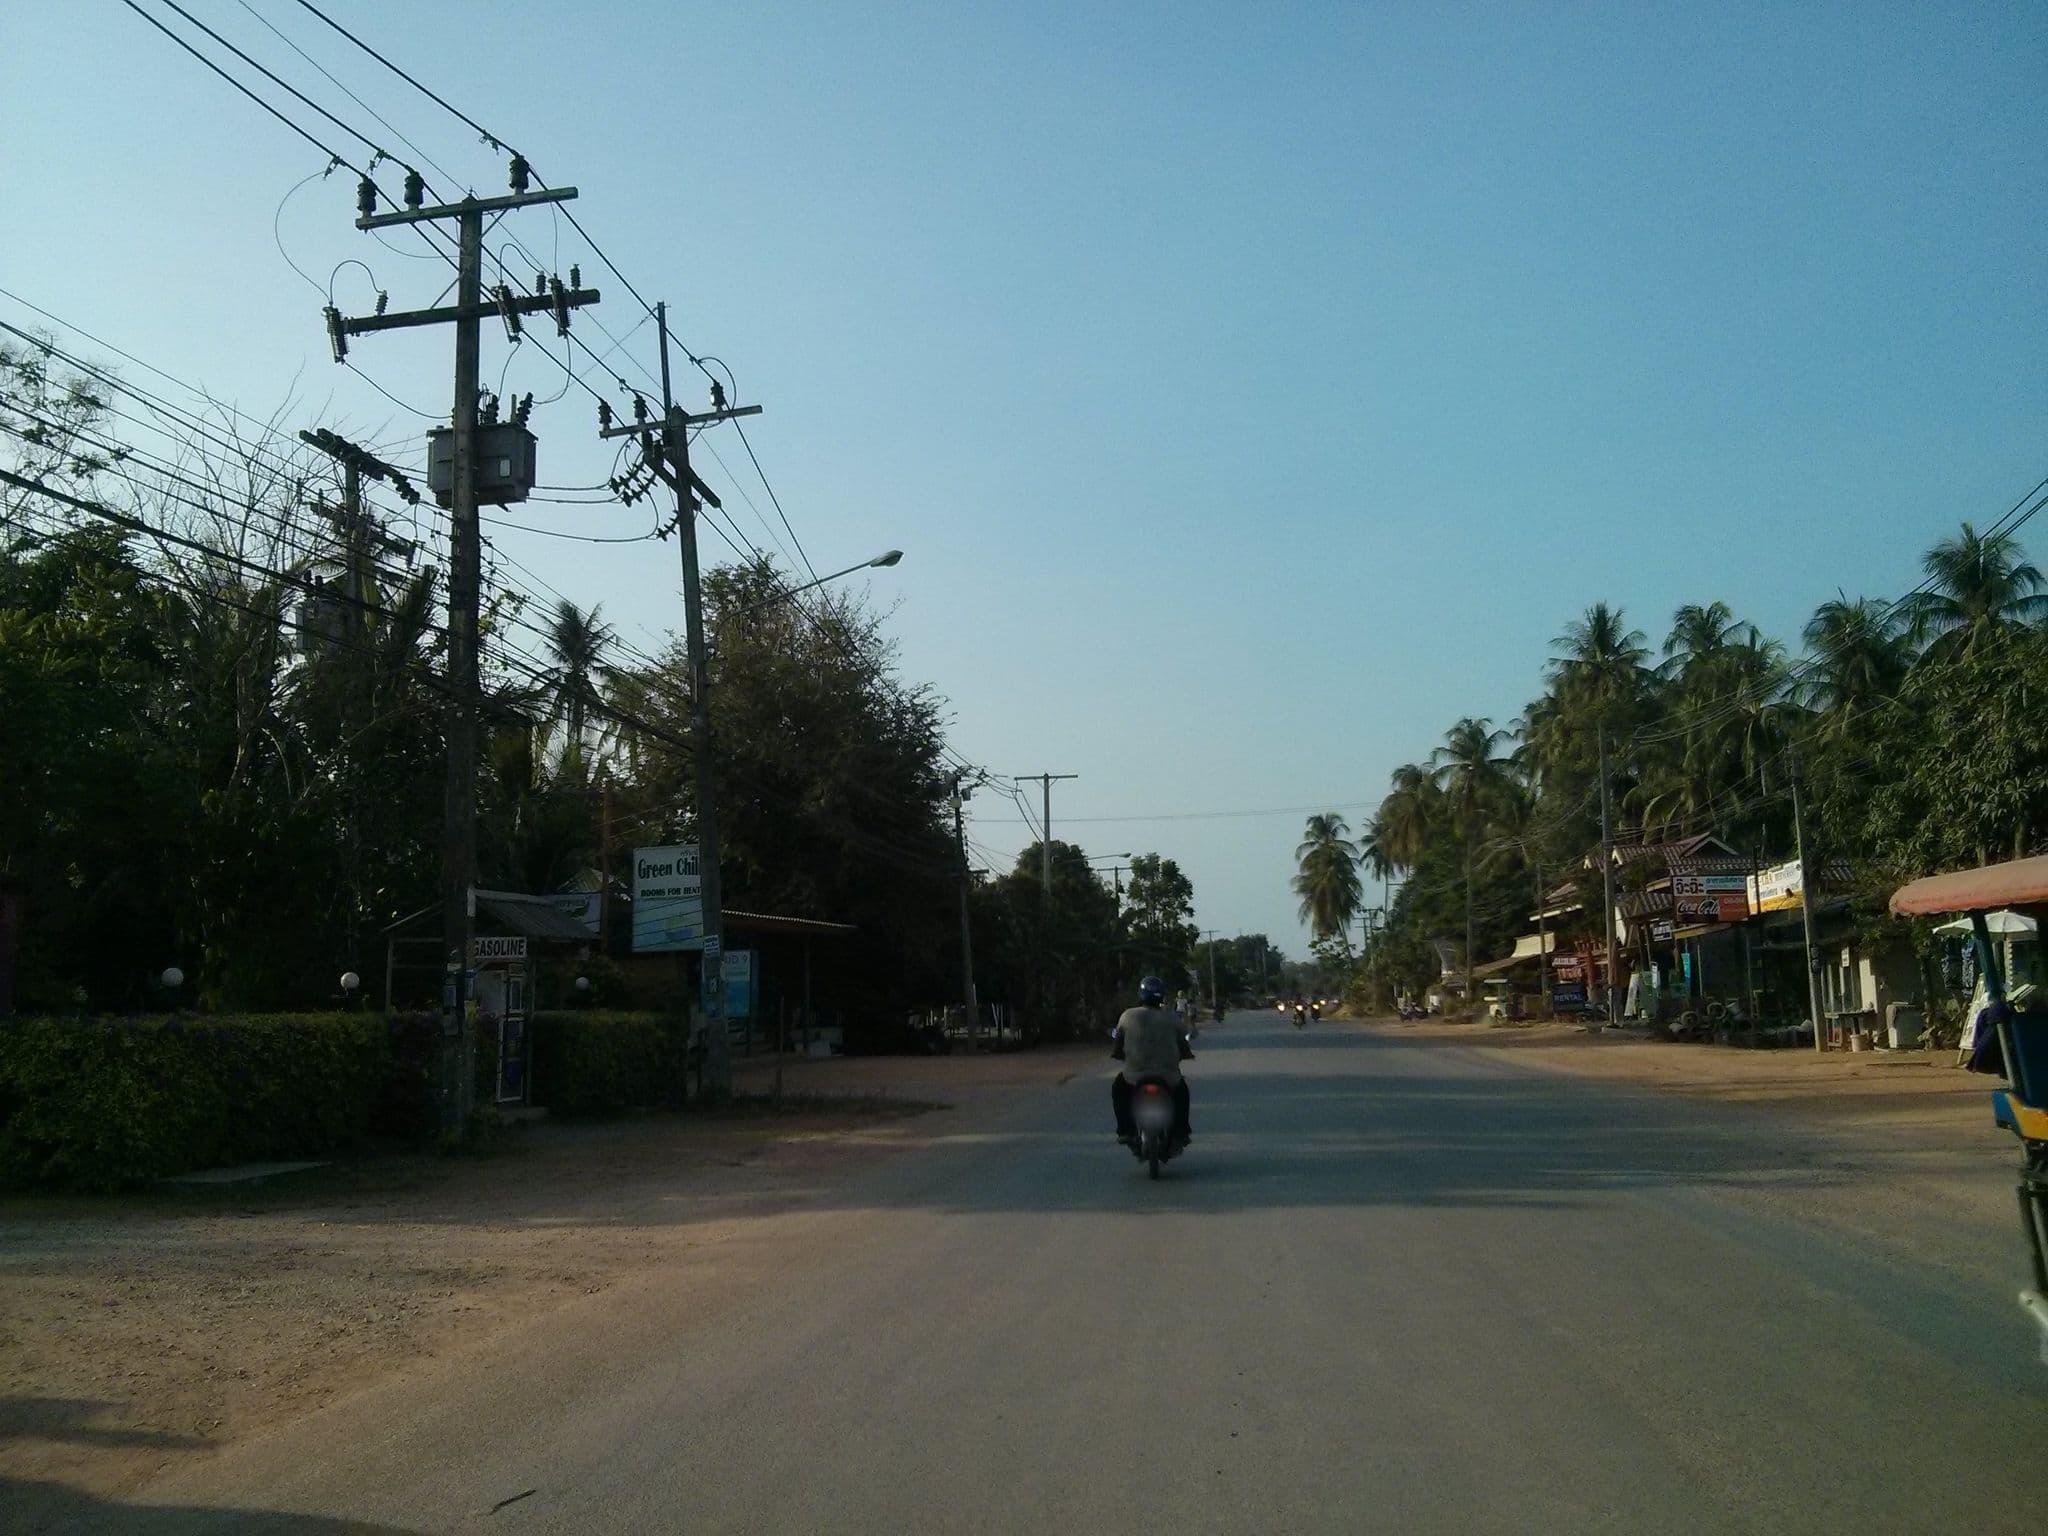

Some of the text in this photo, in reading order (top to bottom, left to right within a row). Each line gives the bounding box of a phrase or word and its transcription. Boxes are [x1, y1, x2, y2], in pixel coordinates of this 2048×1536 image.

[638, 858, 672, 879] Green
[641, 886, 701, 897] ROOMS FOR RENT
[1553, 993, 1583, 1002] RENTAL
